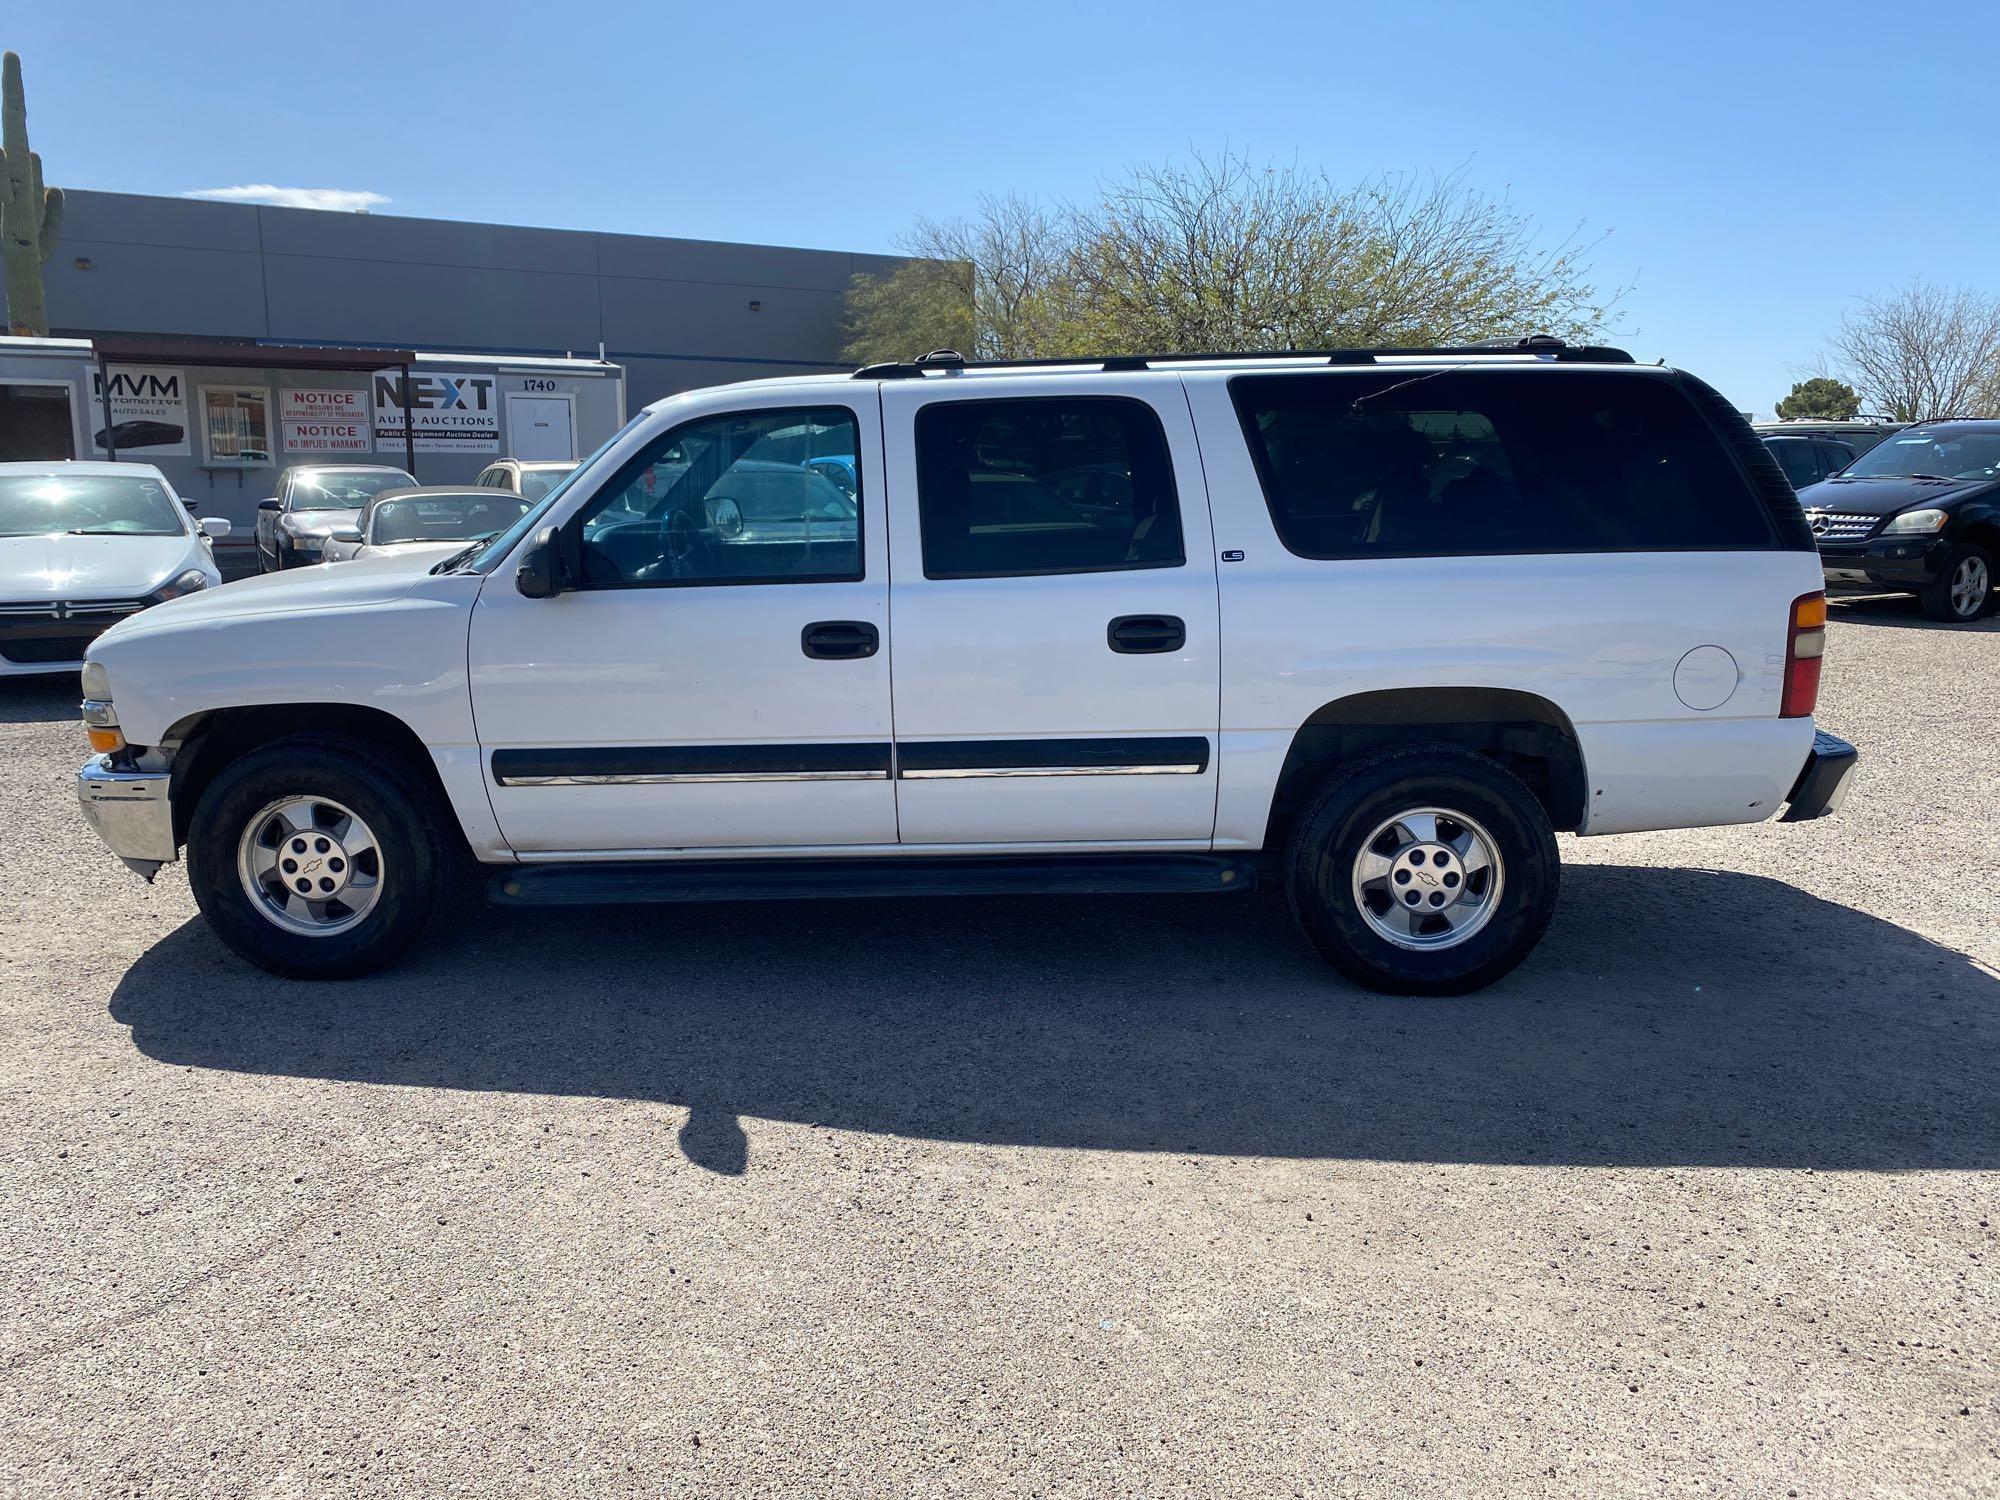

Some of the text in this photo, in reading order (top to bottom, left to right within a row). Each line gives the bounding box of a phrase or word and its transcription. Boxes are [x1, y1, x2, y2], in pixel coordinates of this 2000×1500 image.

[93, 372, 179, 398] MVM
[523, 380, 556, 391] 1740
[375, 375, 493, 411] NEXT
[95, 397, 182, 405] ATOMOTIVE
[294, 393, 355, 404] NOTICE
[421, 416, 494, 426] AUCTIONS
[296, 425, 357, 436] NOTICE
[401, 430, 445, 438] Csignment
[472, 431, 494, 439] Dealer
[288, 439, 367, 449] NO IMPLIED WARRANTY
[1223, 552, 1243, 560] LS
